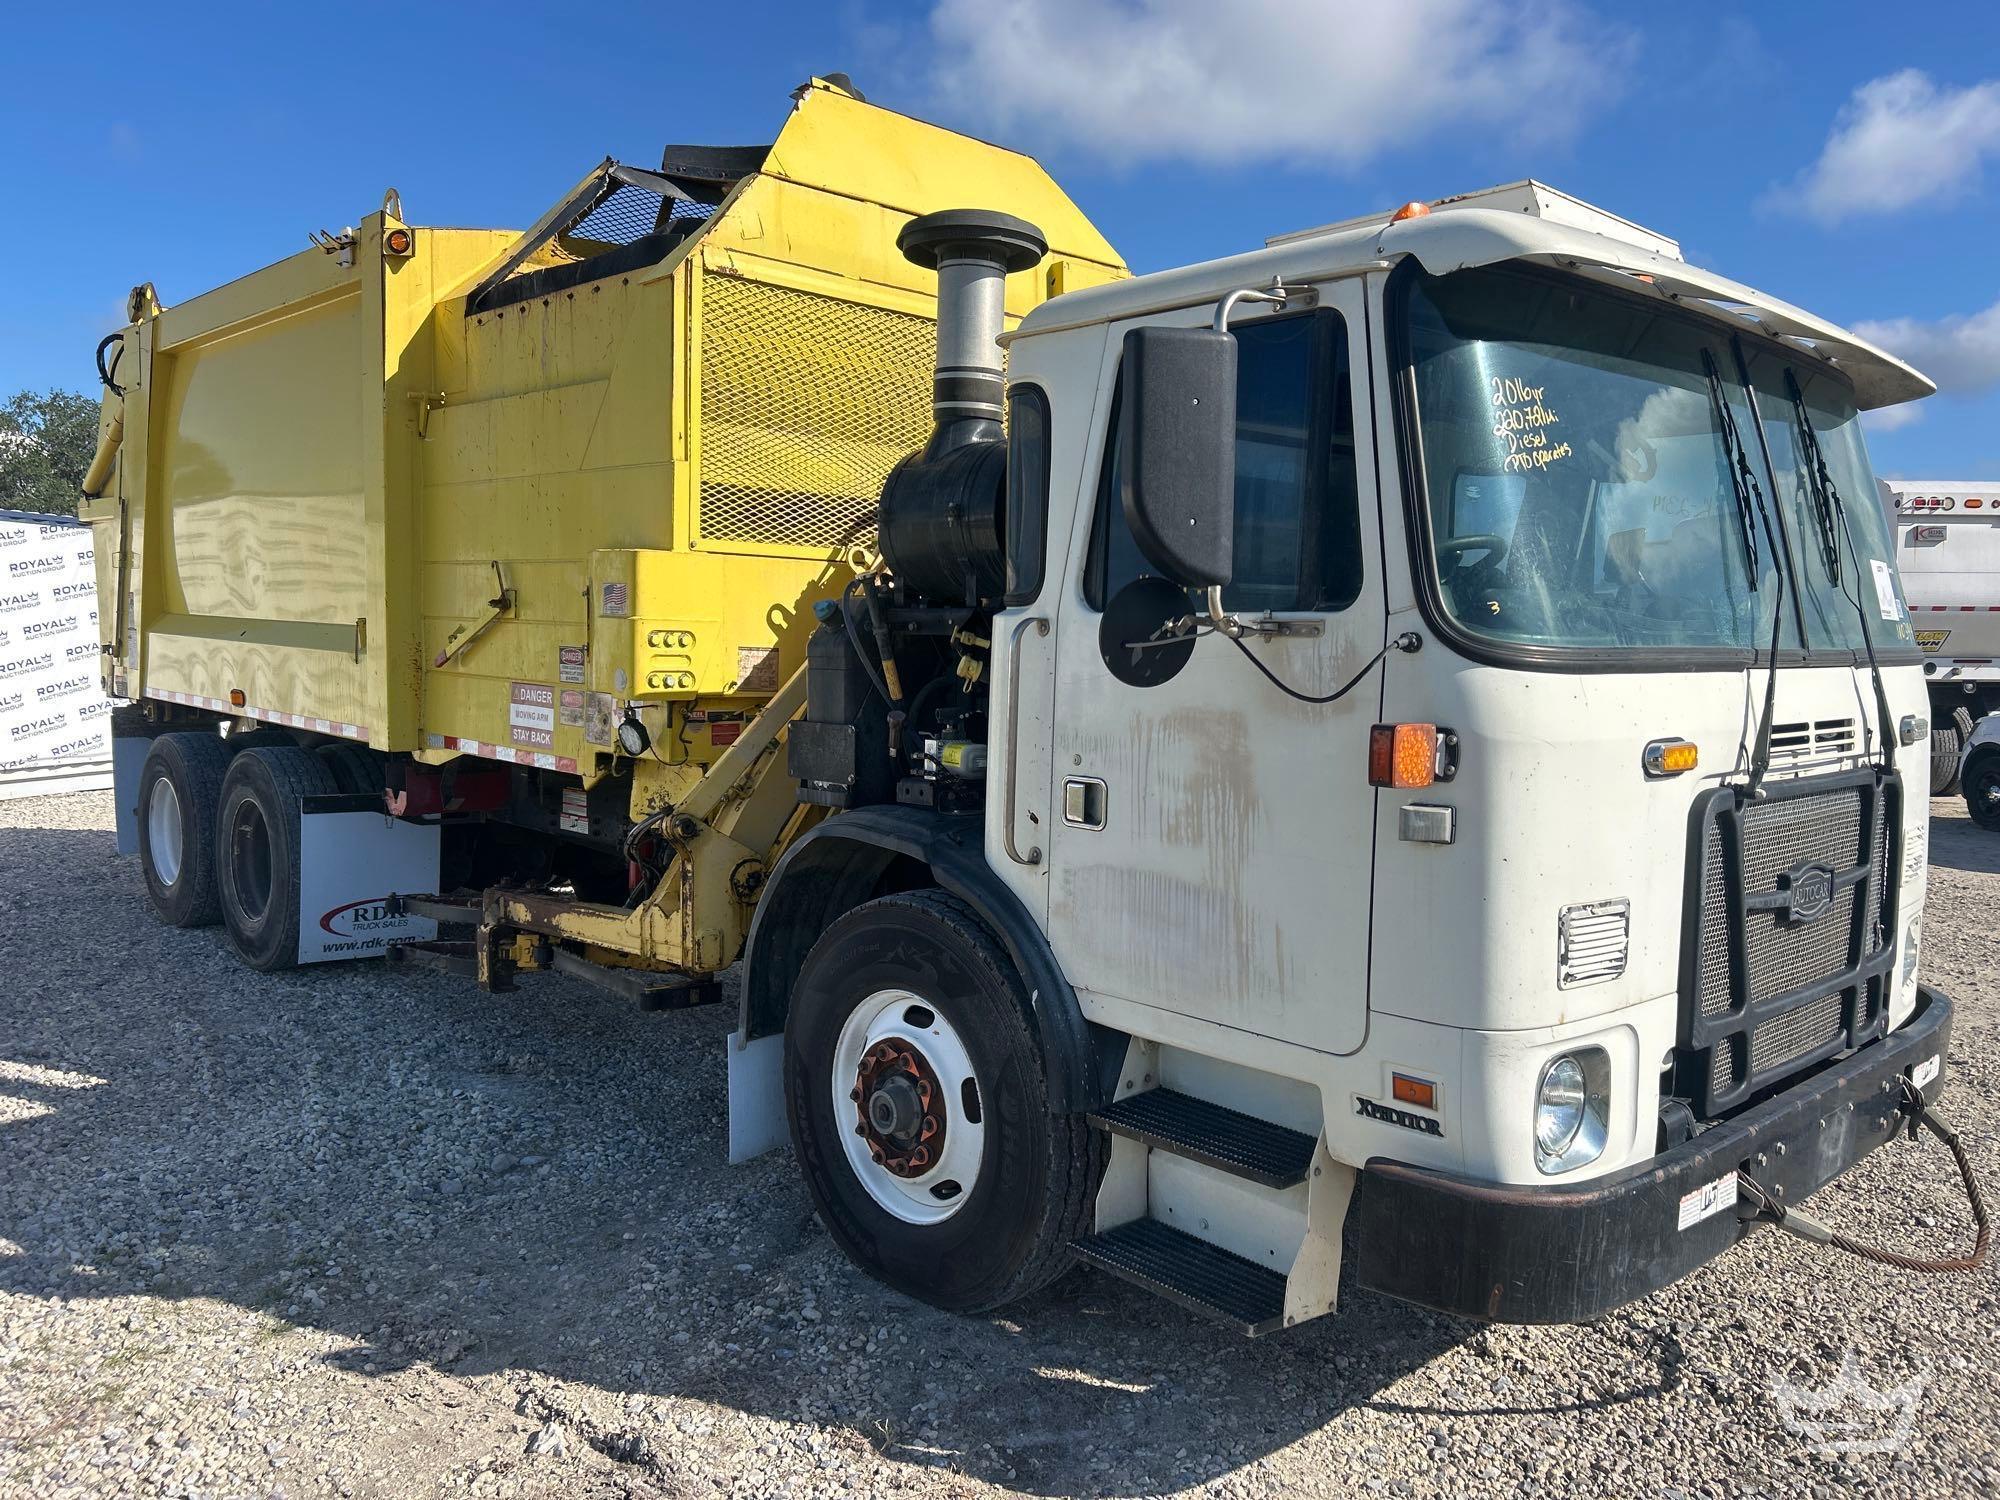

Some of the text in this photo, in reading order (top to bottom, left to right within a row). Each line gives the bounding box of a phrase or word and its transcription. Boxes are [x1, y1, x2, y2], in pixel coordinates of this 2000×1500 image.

[1502, 429, 1547, 453] Diesel
[9, 557, 53, 572] ROYAL
[12, 564, 66, 578] AUCTION GROUP
[53, 581, 94, 597] ROYAL
[0, 594, 29, 607] YAL
[55, 592, 84, 603] AUCTION
[0, 601, 41, 614] TION GROUP
[1486, 601, 1501, 615] 3
[23, 618, 66, 635] ROYAL
[25, 624, 79, 641] AUCTION GROUP
[66, 642, 100, 657] ROYA
[68, 652, 97, 663] AUCTION
[0, 656, 42, 673] ROYAL
[30, 661, 55, 672] GROUP
[36, 679, 79, 697] ROYAL
[39, 684, 92, 702] AUCTION GROUP
[520, 688, 553, 704] DANGER
[79, 699, 119, 716] ROYAL
[515, 709, 536, 719] MOVING
[537, 711, 549, 722] ARM
[11, 716, 55, 736] ROYAL
[13, 721, 68, 742] AUCTION GROUP
[513, 728, 551, 745] STAY BACK
[51, 737, 92, 756] ROYAL
[83, 741, 104, 753] GROUP
[0, 759, 26, 774] YAL
[1793, 882, 1829, 905] AUTOCAR
[353, 919, 409, 931] TRUCK SALES
[323, 935, 416, 953] www.rdk.com
